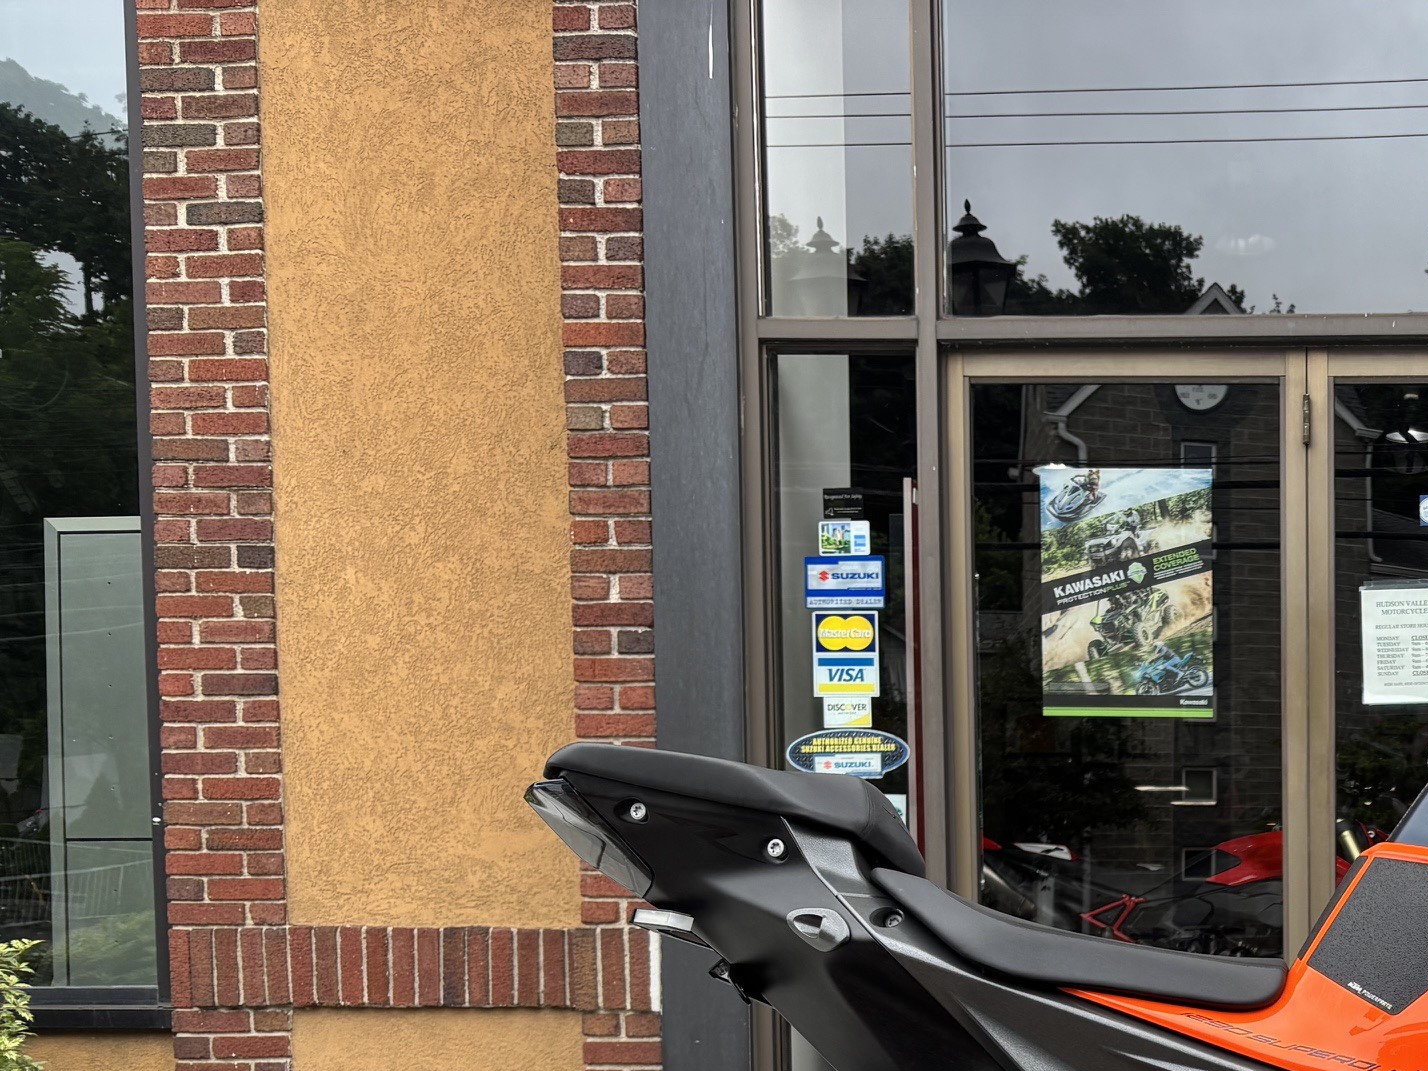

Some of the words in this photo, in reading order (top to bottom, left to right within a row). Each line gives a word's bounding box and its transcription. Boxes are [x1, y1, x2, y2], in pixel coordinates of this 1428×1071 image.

[1153, 548, 1197, 564] EXTENDED
[1153, 554, 1200, 571] COVERAGE
[831, 572, 879, 580] SUZUKI
[1053, 569, 1127, 598] KAWASAKI
[1376, 600, 1405, 608] HUDSON
[827, 668, 866, 682] VISA
[827, 703, 867, 712] DISCOVER
[812, 737, 853, 746] AUTHORIZED
[800, 745, 826, 754] SUZUKI
[834, 761, 871, 769] SUZUKI
